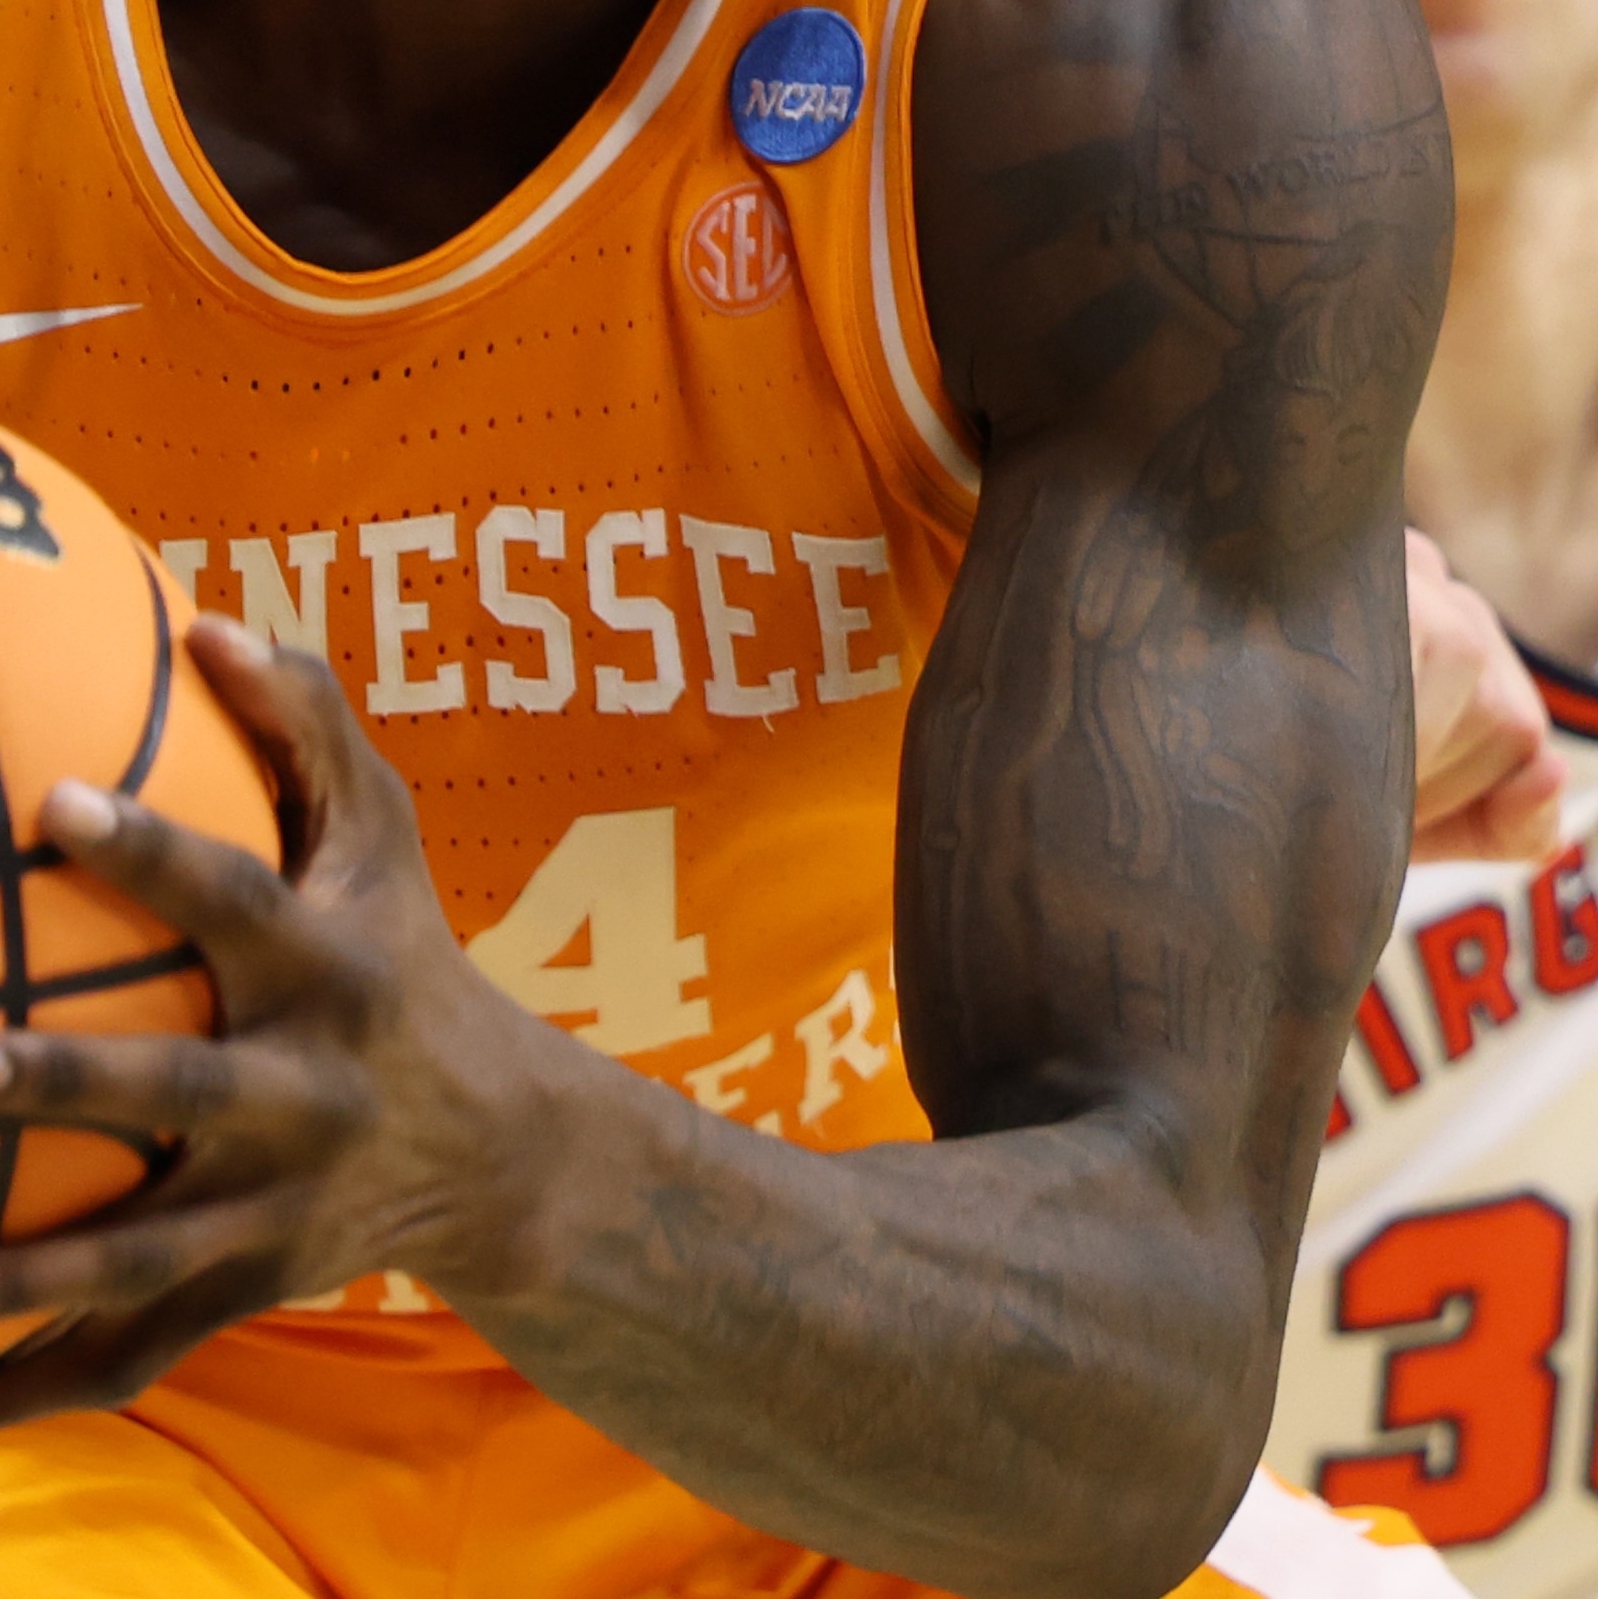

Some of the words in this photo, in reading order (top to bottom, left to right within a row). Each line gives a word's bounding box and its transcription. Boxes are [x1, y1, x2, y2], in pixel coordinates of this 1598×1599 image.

[742, 77, 853, 123] NCAA
[695, 193, 789, 302] SEC
[159, 503, 904, 718] NESSEE
